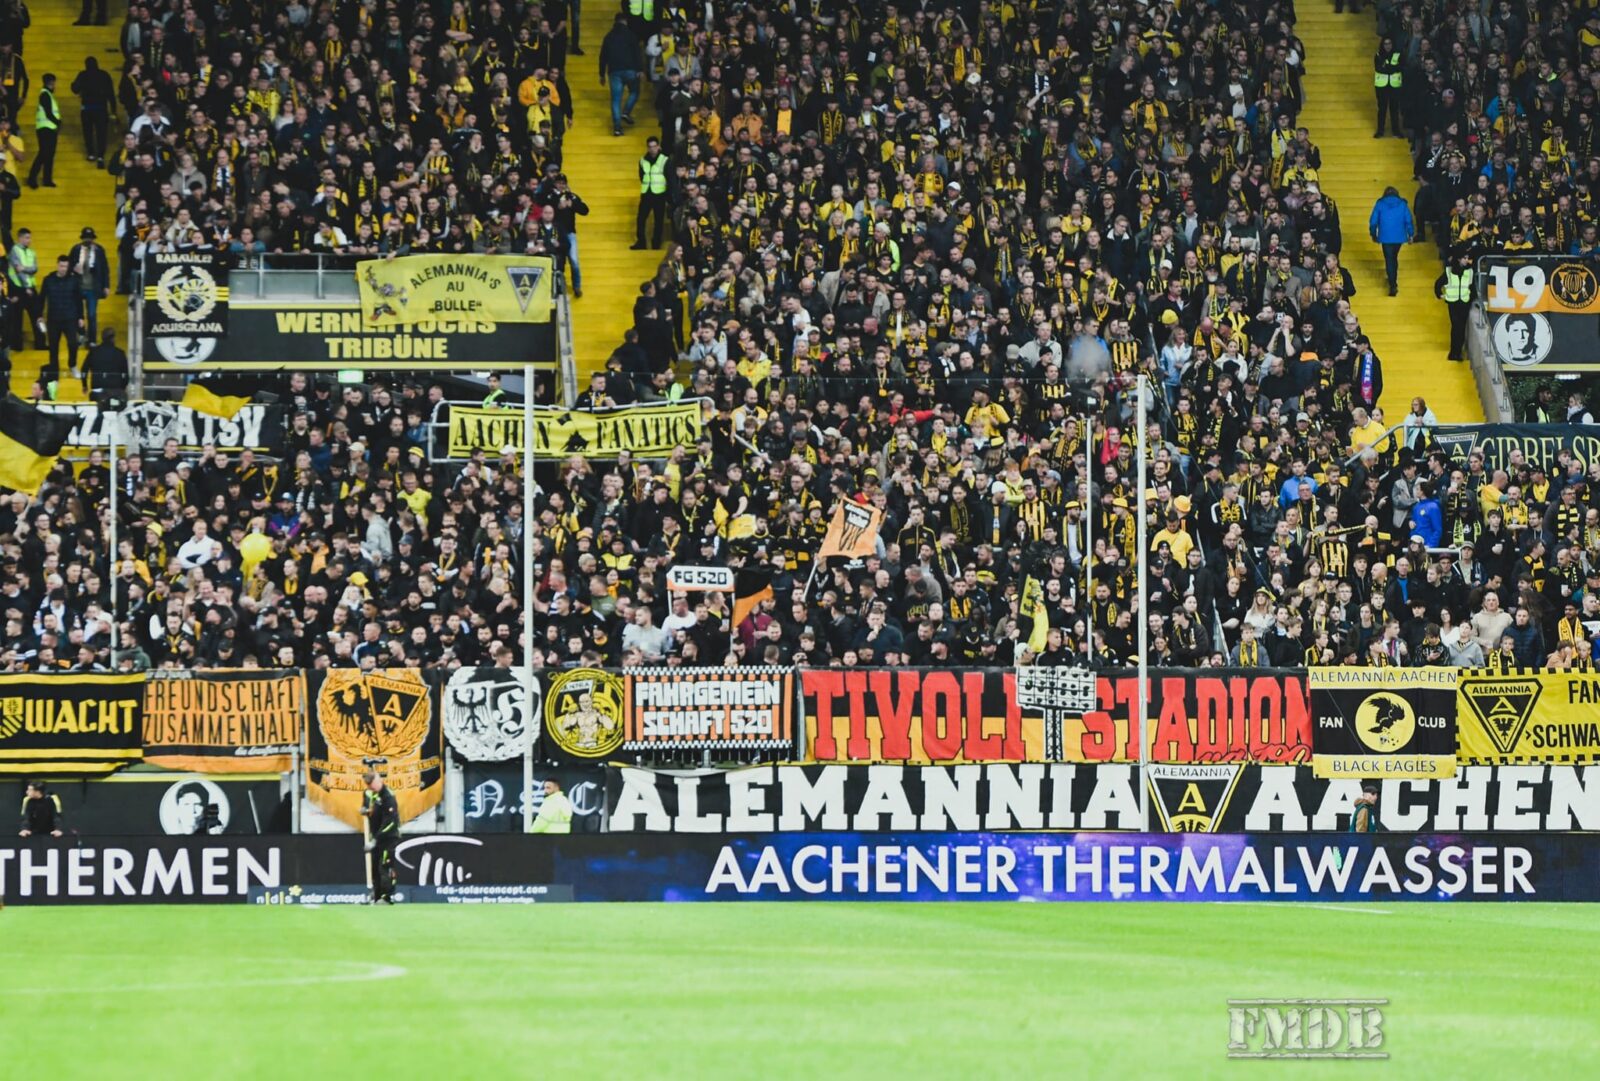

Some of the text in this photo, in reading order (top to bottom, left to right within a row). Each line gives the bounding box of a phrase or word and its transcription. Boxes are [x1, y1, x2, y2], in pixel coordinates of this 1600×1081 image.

[446, 282, 465, 292] AU
[1489, 265, 1544, 308] 19
[151, 322, 223, 333] AQUISGRANA
[325, 334, 448, 358] TRIBÜNE
[453, 413, 697, 450] AACHN FANATICS
[674, 571, 727, 585] FG 520
[369, 678, 422, 694] ALEMANNIA
[1311, 669, 1457, 683] ALEMANNIA AACHEN
[144, 678, 295, 712] FREUNDSCHAFT
[1472, 685, 1531, 695] ALEMANNIA
[25, 699, 138, 734] WACHT
[142, 711, 297, 744] ZUSAMMENHALT
[643, 709, 772, 736] SCHAFT 520
[802, 670, 1314, 763] TIVOLI STADION
[1319, 716, 1447, 729] FAN CLUB
[1153, 767, 1232, 777] ALEMANNIA
[1333, 760, 1437, 773] BLACK EAGLES
[608, 765, 1600, 832] ALEMANNIA AACHEN
[705, 845, 1537, 894] AACHENER THERMALWASSER
